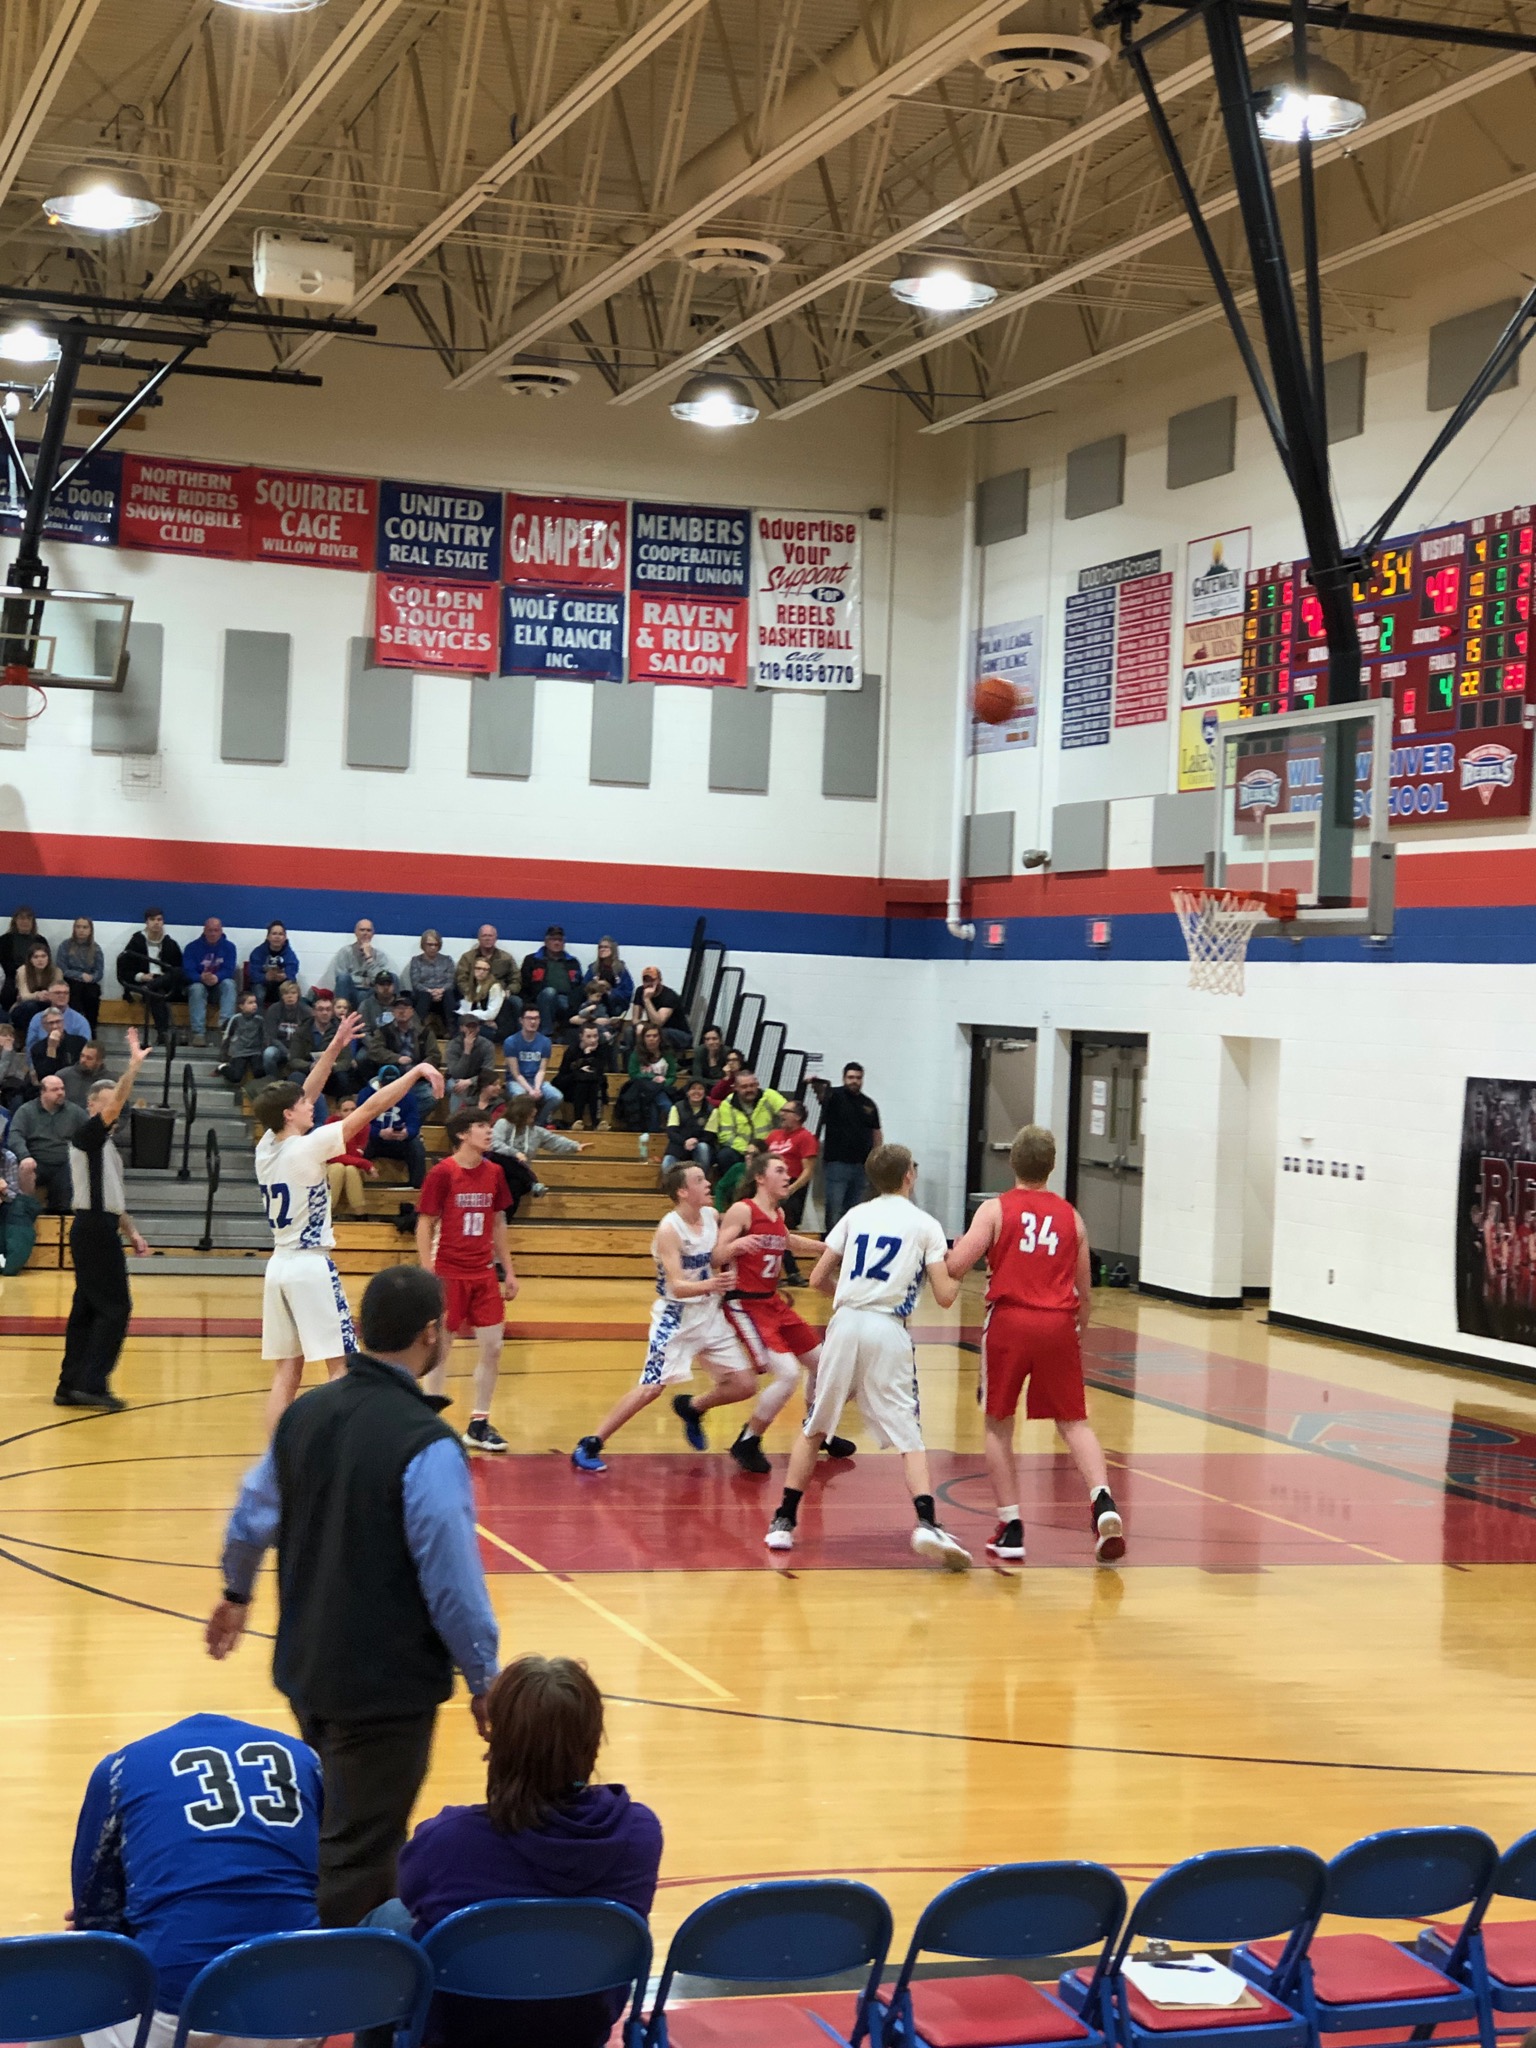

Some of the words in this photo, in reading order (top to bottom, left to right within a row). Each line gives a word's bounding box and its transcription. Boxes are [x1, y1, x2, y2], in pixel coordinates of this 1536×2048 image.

[140, 466, 232, 491] NORTHERN
[68, 487, 115, 508] DOOR
[131, 484, 172, 504] PINE
[178, 489, 239, 509] RIDERS
[255, 479, 370, 515] SQUIRREL
[400, 493, 485, 521] UNITED
[73, 509, 112, 523] OWNER
[126, 503, 242, 530] SNOWMOBILE
[280, 511, 342, 541] CAGE
[160, 525, 205, 544] CLUB
[384, 517, 495, 548] COUNTRY
[509, 513, 622, 570] GAMPERS
[637, 513, 745, 546] MEMBERS
[759, 517, 856, 544] Advertise
[262, 538, 316, 556] WILLOW
[319, 543, 358, 560] RIVER
[389, 544, 430, 566] REAL
[434, 548, 489, 570] ESTATE
[638, 544, 743, 567] COOPERATIVE
[782, 543, 831, 566] Your
[1498, 533, 1508, 558] 2
[636, 563, 691, 583] CREDIT
[695, 566, 744, 586] UNION
[759, 562, 852, 597] Support
[389, 586, 483, 610] GOLDEN
[509, 597, 558, 621] WOLF
[562, 601, 619, 625] CREEK
[1250, 589, 1258, 611] 3
[1267, 585, 1275, 607] 3
[396, 606, 475, 630] TOUCH
[643, 602, 733, 629] RAVEN
[776, 604, 836, 626] REBELS
[1494, 601, 1504, 625] 2
[379, 625, 492, 651] SERVICES
[514, 624, 548, 646] ELK
[552, 627, 611, 651] RANCH
[636, 628, 655, 649] &
[662, 628, 739, 654] RUBY
[759, 626, 854, 650] BASKETBALL
[1380, 616, 1394, 652] 2
[545, 652, 578, 669] INC.
[649, 653, 725, 675] SALON
[1439, 674, 1453, 708] 4
[1460, 671, 1480, 696] 22
[1286, 751, 1373, 788] WILW
[463, 1212, 485, 1236] 10
[1019, 1211, 1059, 1256] 34
[850, 1233, 902, 1282] 12
[170, 1741, 303, 1832] 33
